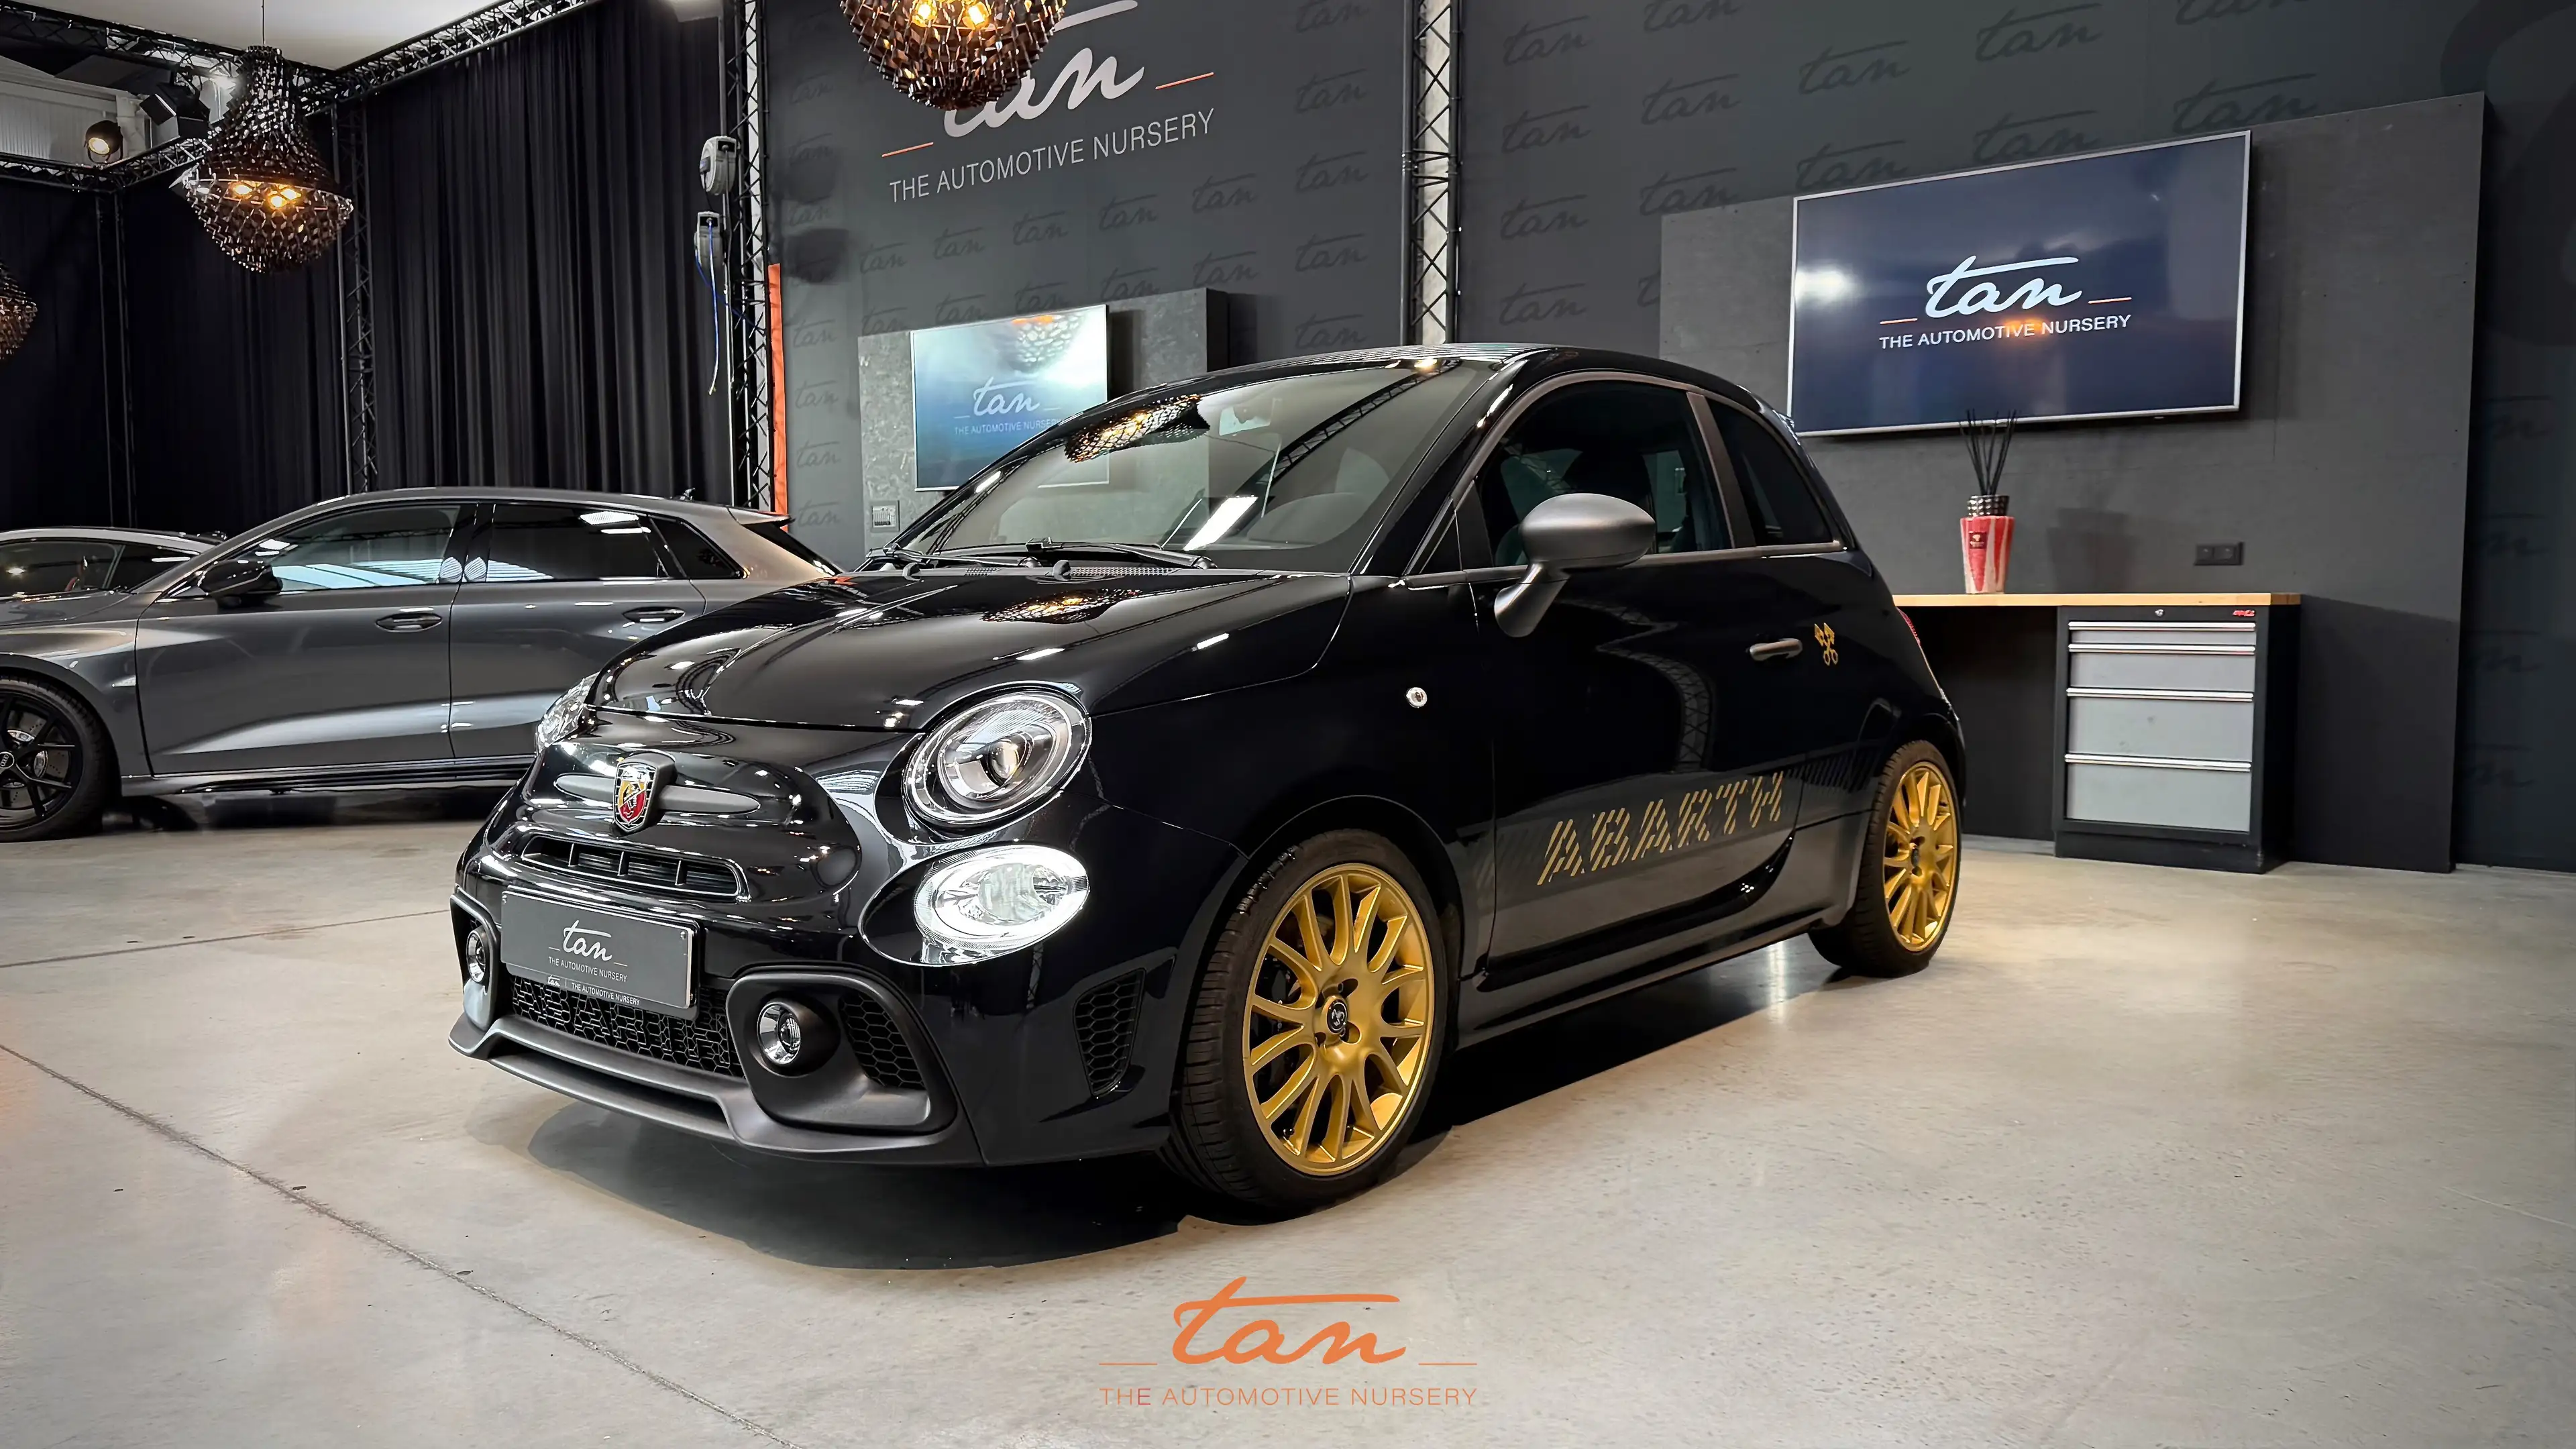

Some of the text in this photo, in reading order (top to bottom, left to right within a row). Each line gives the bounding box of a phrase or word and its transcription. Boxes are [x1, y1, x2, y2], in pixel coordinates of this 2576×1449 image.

[1503, 15, 1592, 66] tan
[1974, 2, 2104, 62] tan
[1798, 40, 1912, 95] tan
[1295, 68, 1368, 114] tan
[1642, 73, 1742, 125] tan
[2171, 72, 2319, 135] tan
[1501, 105, 1592, 154] tan
[1972, 109, 2100, 164] tan
[890, 108, 1214, 203] THE AUTOMOTIVE NURSERY
[1295, 150, 1369, 193] tan
[1795, 139, 1909, 191] tan
[1098, 195, 1159, 231] tan
[1191, 173, 1258, 213] tan
[1640, 167, 1739, 216] tan
[1012, 209, 1069, 246] tan
[1501, 194, 1589, 240] tan
[860, 242, 908, 274] tan
[933, 227, 985, 260] tan
[1295, 233, 1369, 272] tan
[1099, 267, 1161, 302] tan
[1193, 251, 1259, 288] tan
[1925, 255, 2082, 319] tan
[1499, 282, 1588, 325] tan
[1295, 313, 1368, 350] tan
[1879, 314, 2132, 350] THE AUTOMOTIVE NURSERY
[973, 376, 1040, 416] tan
[955, 426, 969, 435] THE
[971, 421, 1022, 435] AUTOMOTIVE
[1537, 771, 1784, 885] ABARTH
[562, 920, 612, 961] tan
[547, 975, 641, 1006] tan THE AUTOMOTIVE NURSERY
[548, 956, 628, 983] THE AUTOMOTIVE NURSERY
